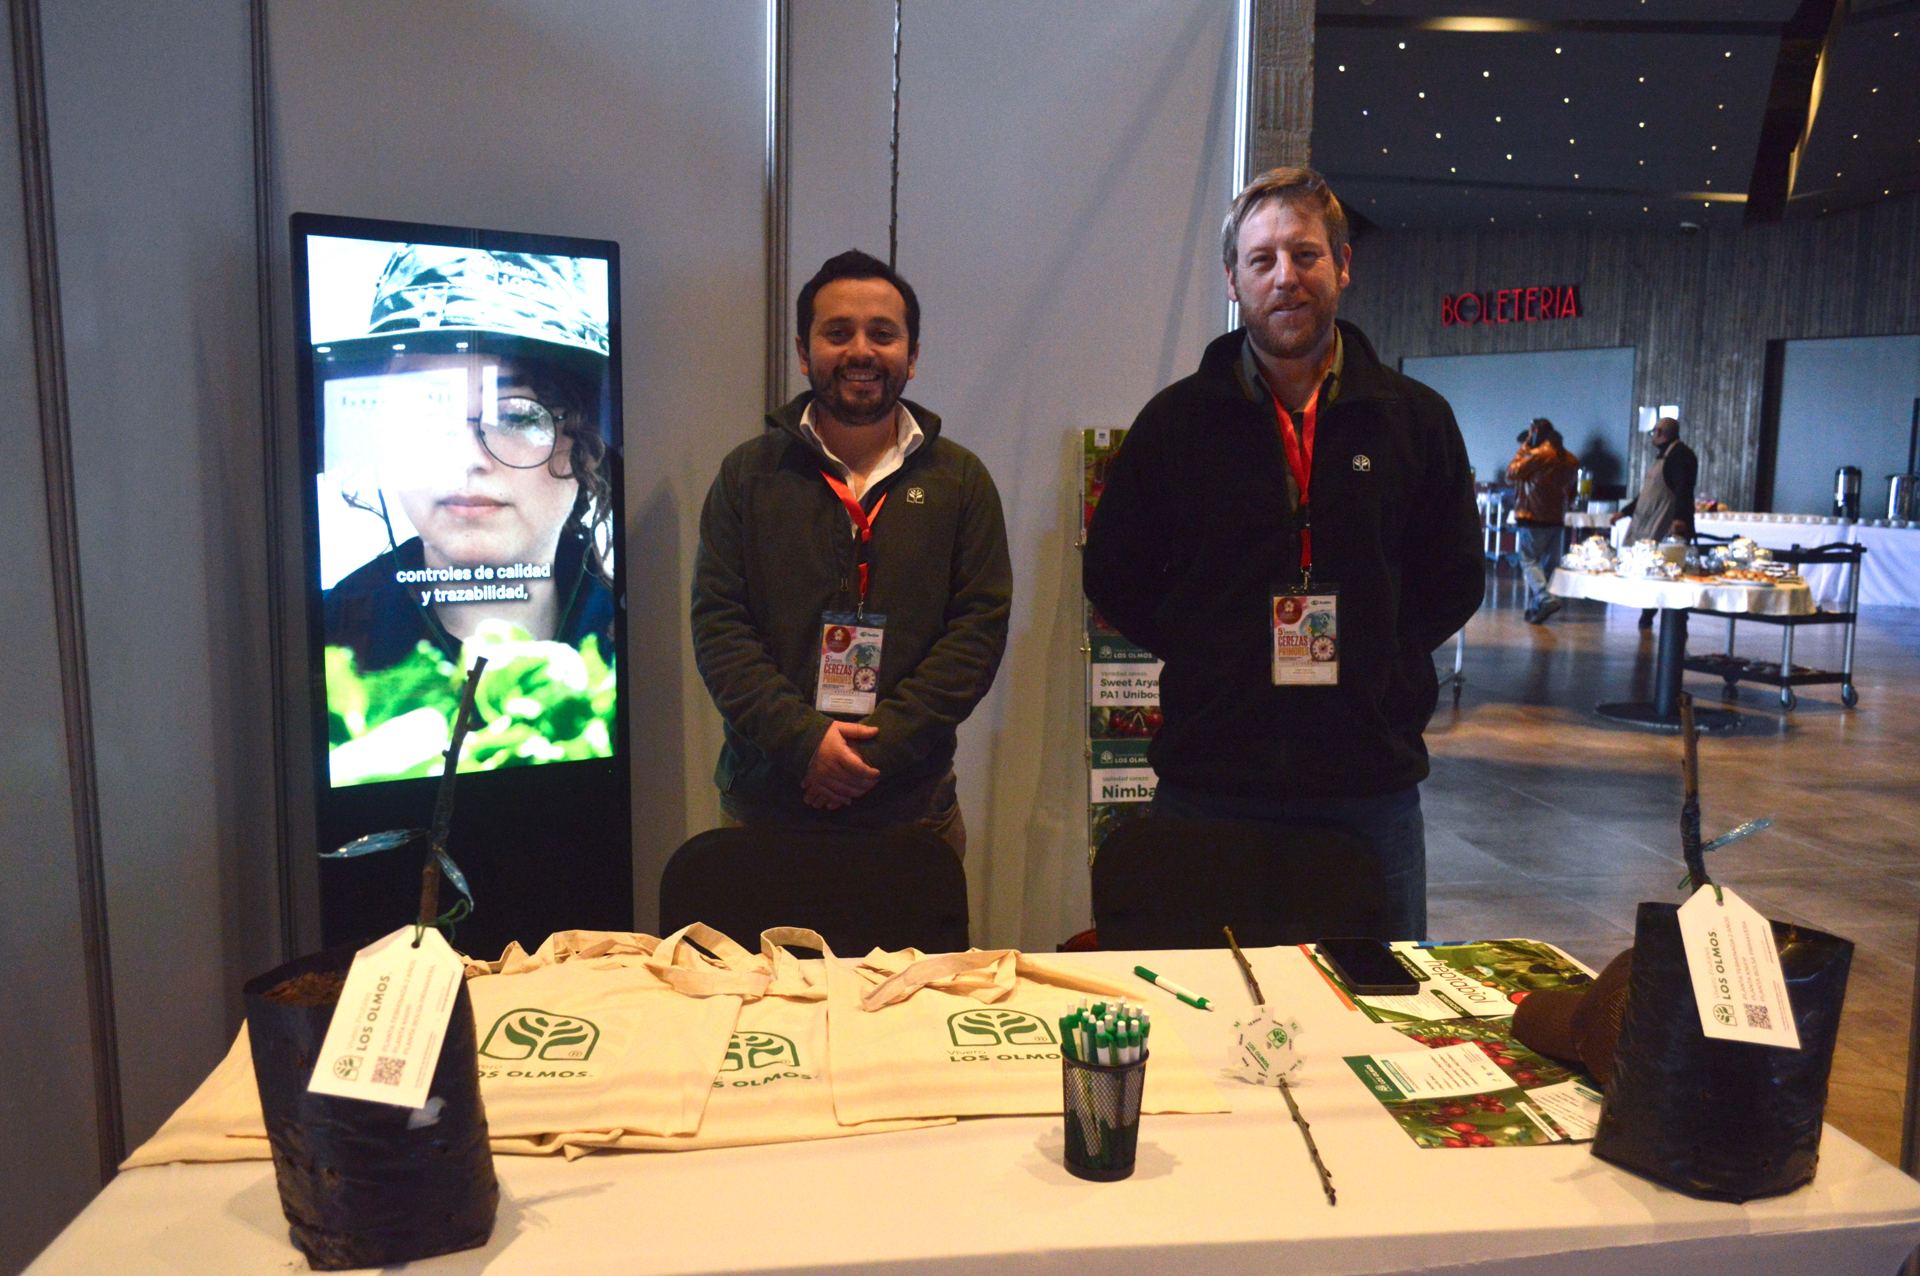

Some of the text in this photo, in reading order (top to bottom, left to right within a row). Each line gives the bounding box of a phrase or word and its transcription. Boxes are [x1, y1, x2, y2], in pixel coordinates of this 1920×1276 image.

[1440, 286, 1578, 328] BOLETERIA
[396, 562, 551, 583] controles de calidad
[421, 584, 529, 606] y trazabilidad,
[1277, 635, 1308, 647] CEREZAS
[823, 663, 853, 675] CEREZAS
[1100, 679, 1132, 687] Sweet
[1100, 691, 1119, 699] PA1
[1102, 784, 1158, 799] Nimba
[1708, 931, 1731, 1000] LOS OLMOS
[1424, 959, 1498, 1004] heptabiol
[356, 975, 390, 1051] LOS OLMOS
[949, 1055, 990, 1063] LOS
